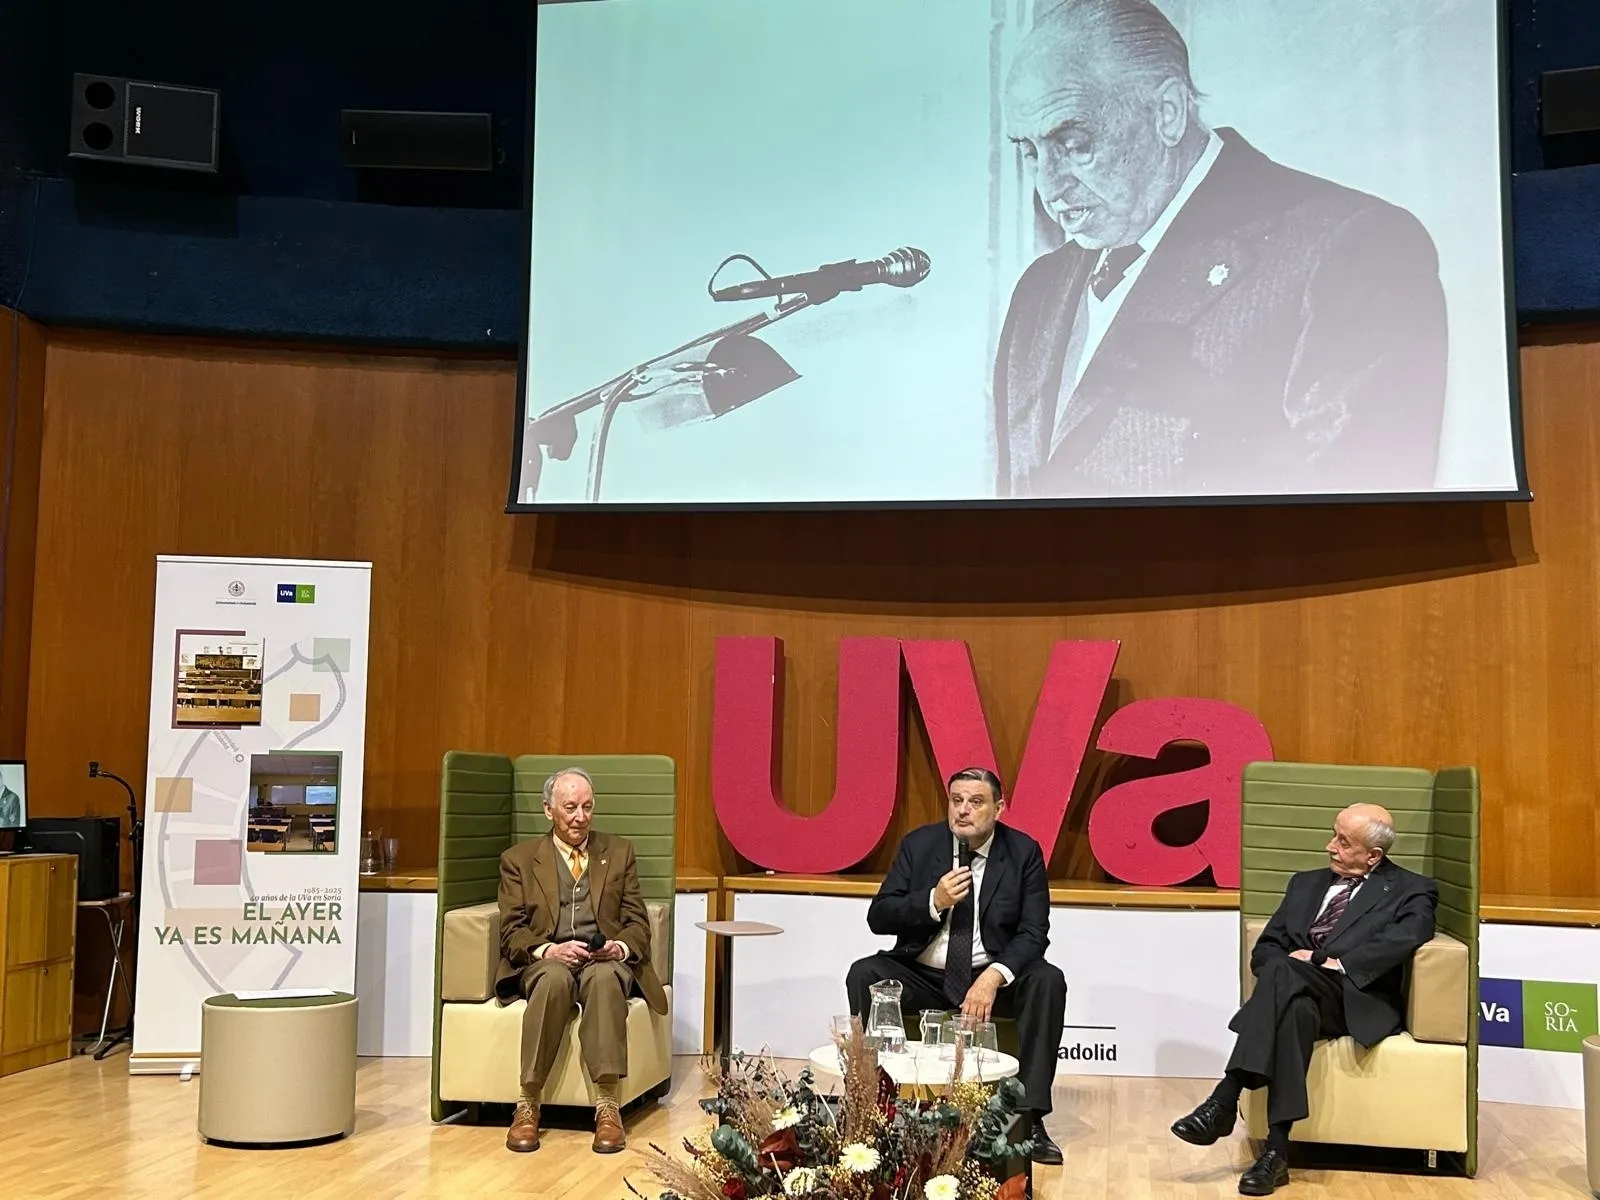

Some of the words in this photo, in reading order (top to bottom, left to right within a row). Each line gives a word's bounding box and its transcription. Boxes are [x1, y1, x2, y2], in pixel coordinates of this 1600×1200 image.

[711, 636, 1275, 889] UVa
[303, 887, 342, 895] 1985-2025
[243, 902, 272, 921] EL
[280, 902, 342, 921] AYER
[154, 926, 184, 945] YA
[194, 926, 222, 945] ES
[231, 920, 342, 945] MAÑANA
[1477, 1001, 1510, 1023] Va
[1545, 1016, 1578, 1033] RIA
[1057, 1042, 1117, 1061] adolid
